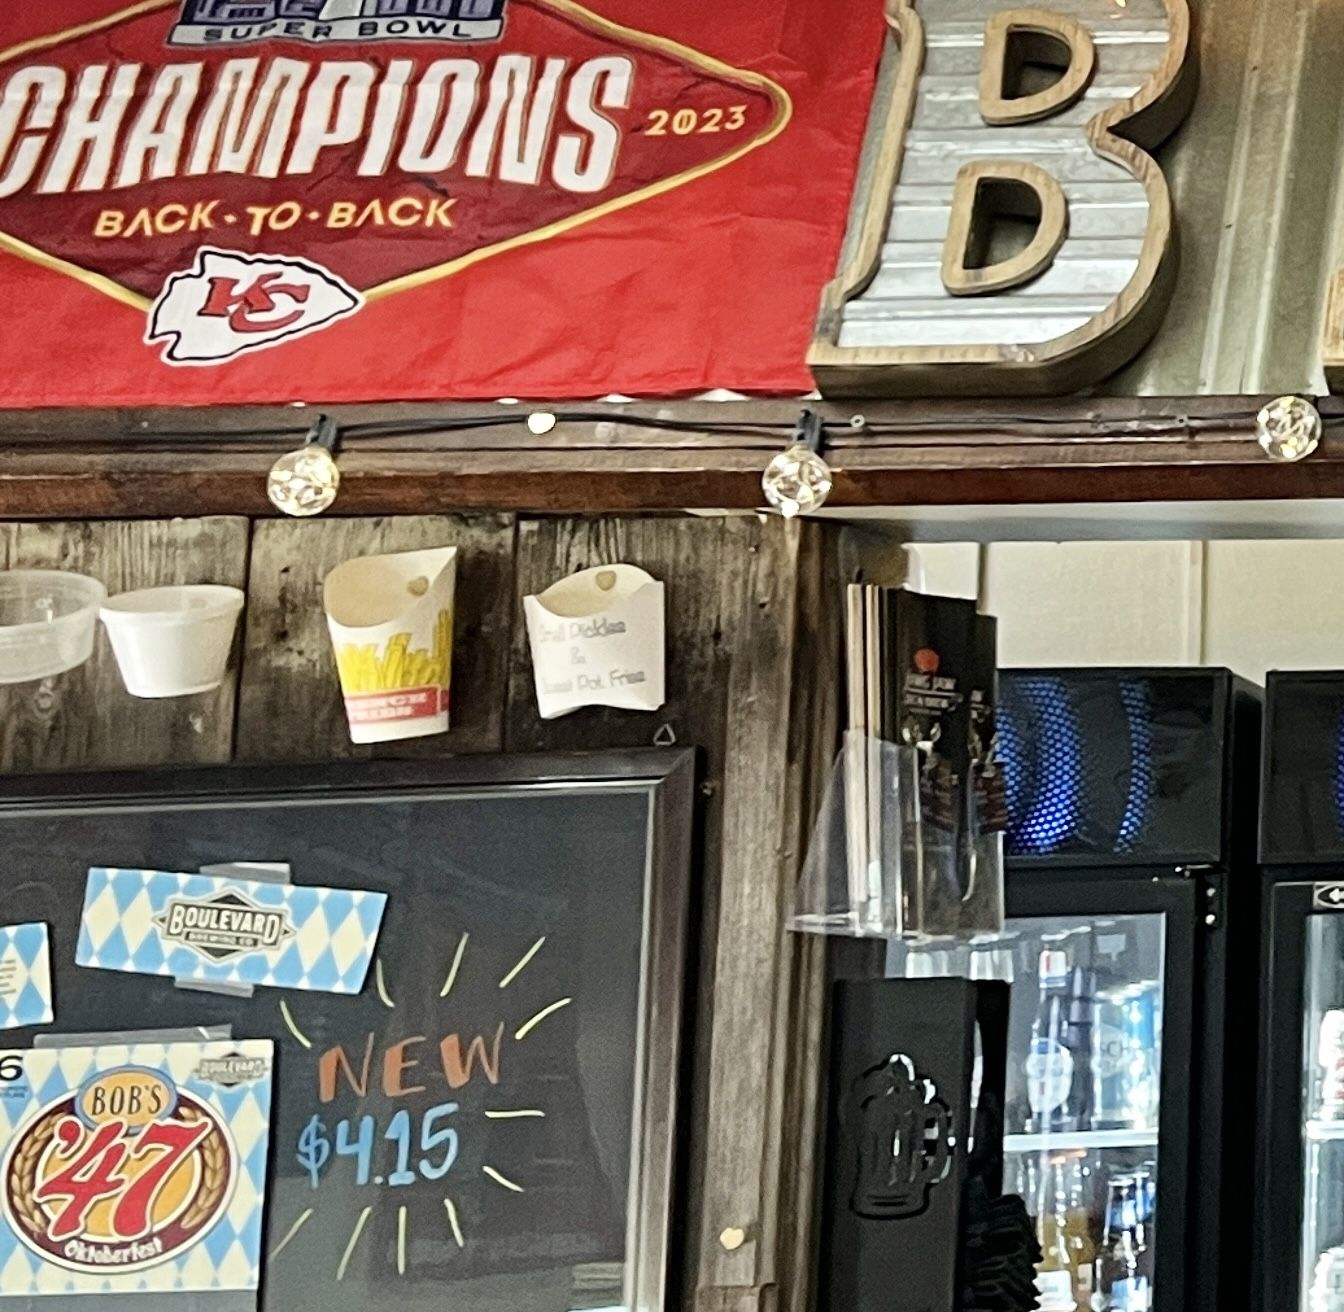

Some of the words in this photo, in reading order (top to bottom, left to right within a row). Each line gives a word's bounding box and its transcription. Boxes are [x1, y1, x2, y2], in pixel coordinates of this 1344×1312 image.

[204, 21, 333, 42] SUPER
[358, 18, 473, 38] BOWL
[0, 54, 635, 195] CHAMPIONS
[645, 105, 747, 138] 2023
[94, 199, 219, 237] BACK
[246, 201, 301, 237] TO
[326, 197, 454, 231] BACK
[197, 271, 311, 334] KC
[168, 904, 281, 944] BOULEVARD
[319, 1022, 504, 1104] NEW
[92, 1084, 162, 1117] BOB'S
[297, 1102, 460, 1189] $4.15
[64, 1238, 163, 1264] Oktoberfest
